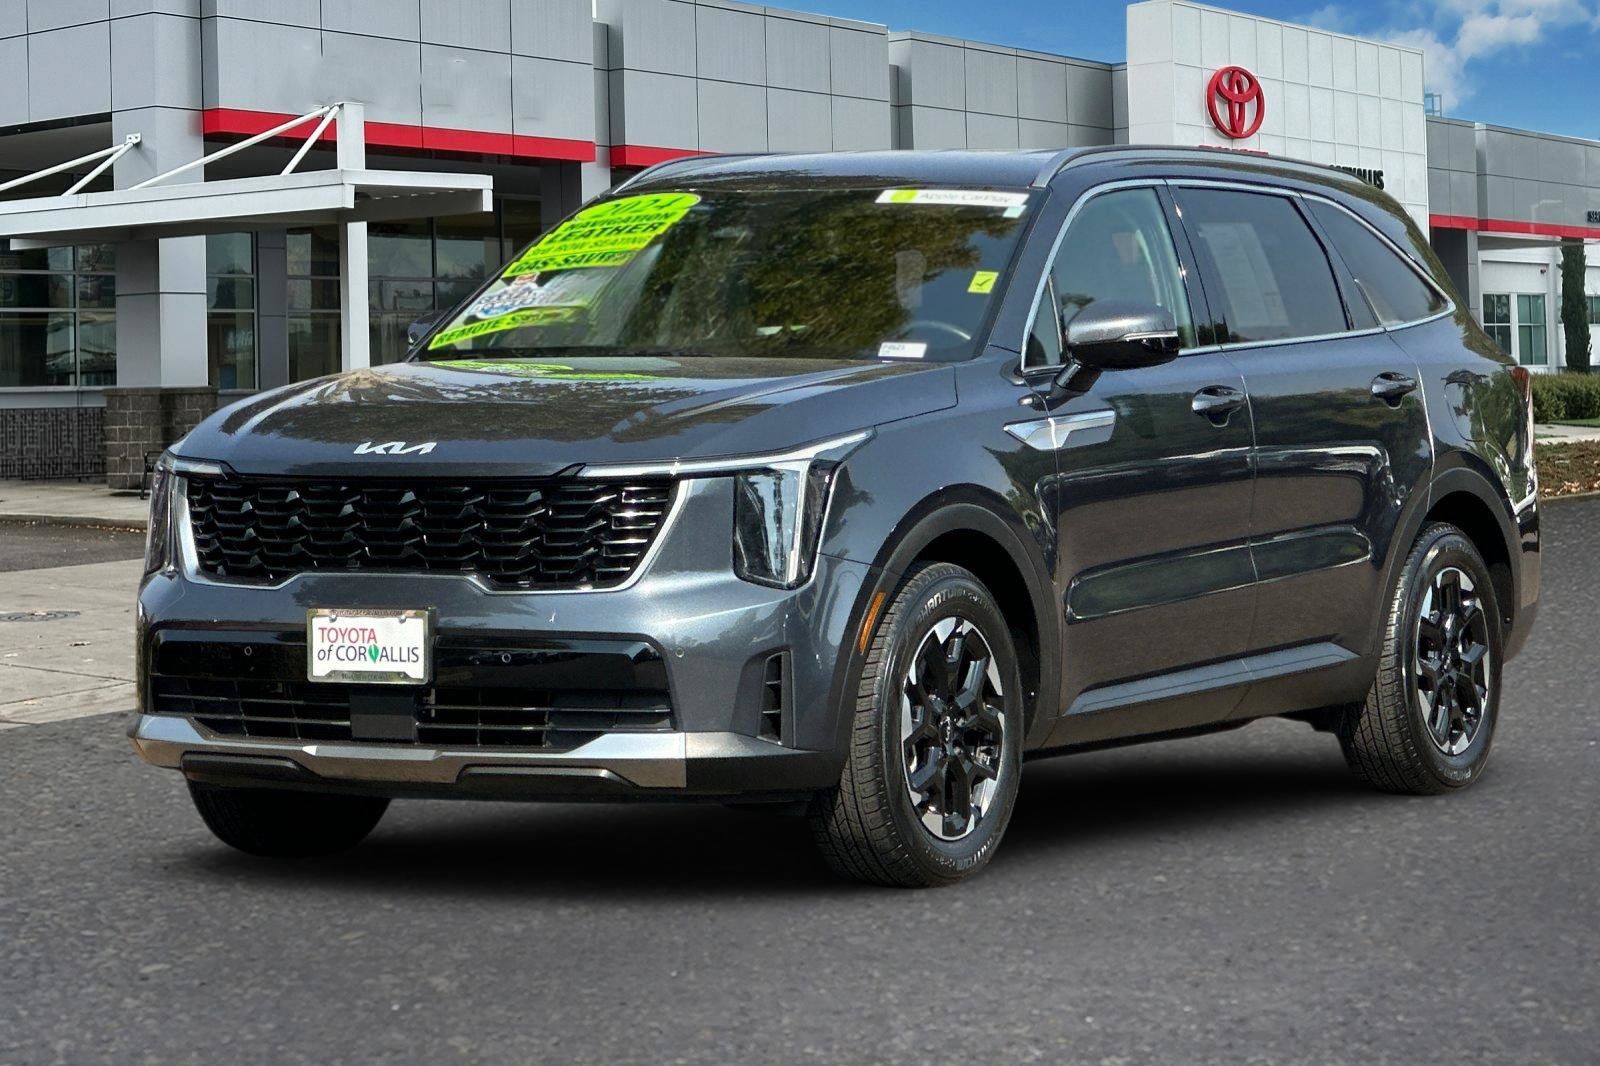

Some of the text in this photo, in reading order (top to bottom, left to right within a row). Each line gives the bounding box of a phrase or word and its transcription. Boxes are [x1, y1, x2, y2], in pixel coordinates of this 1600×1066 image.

[545, 222, 664, 244] LEATHER
[354, 441, 437, 455] KIA
[318, 627, 378, 644] TOYOTA
[317, 644, 334, 661] of
